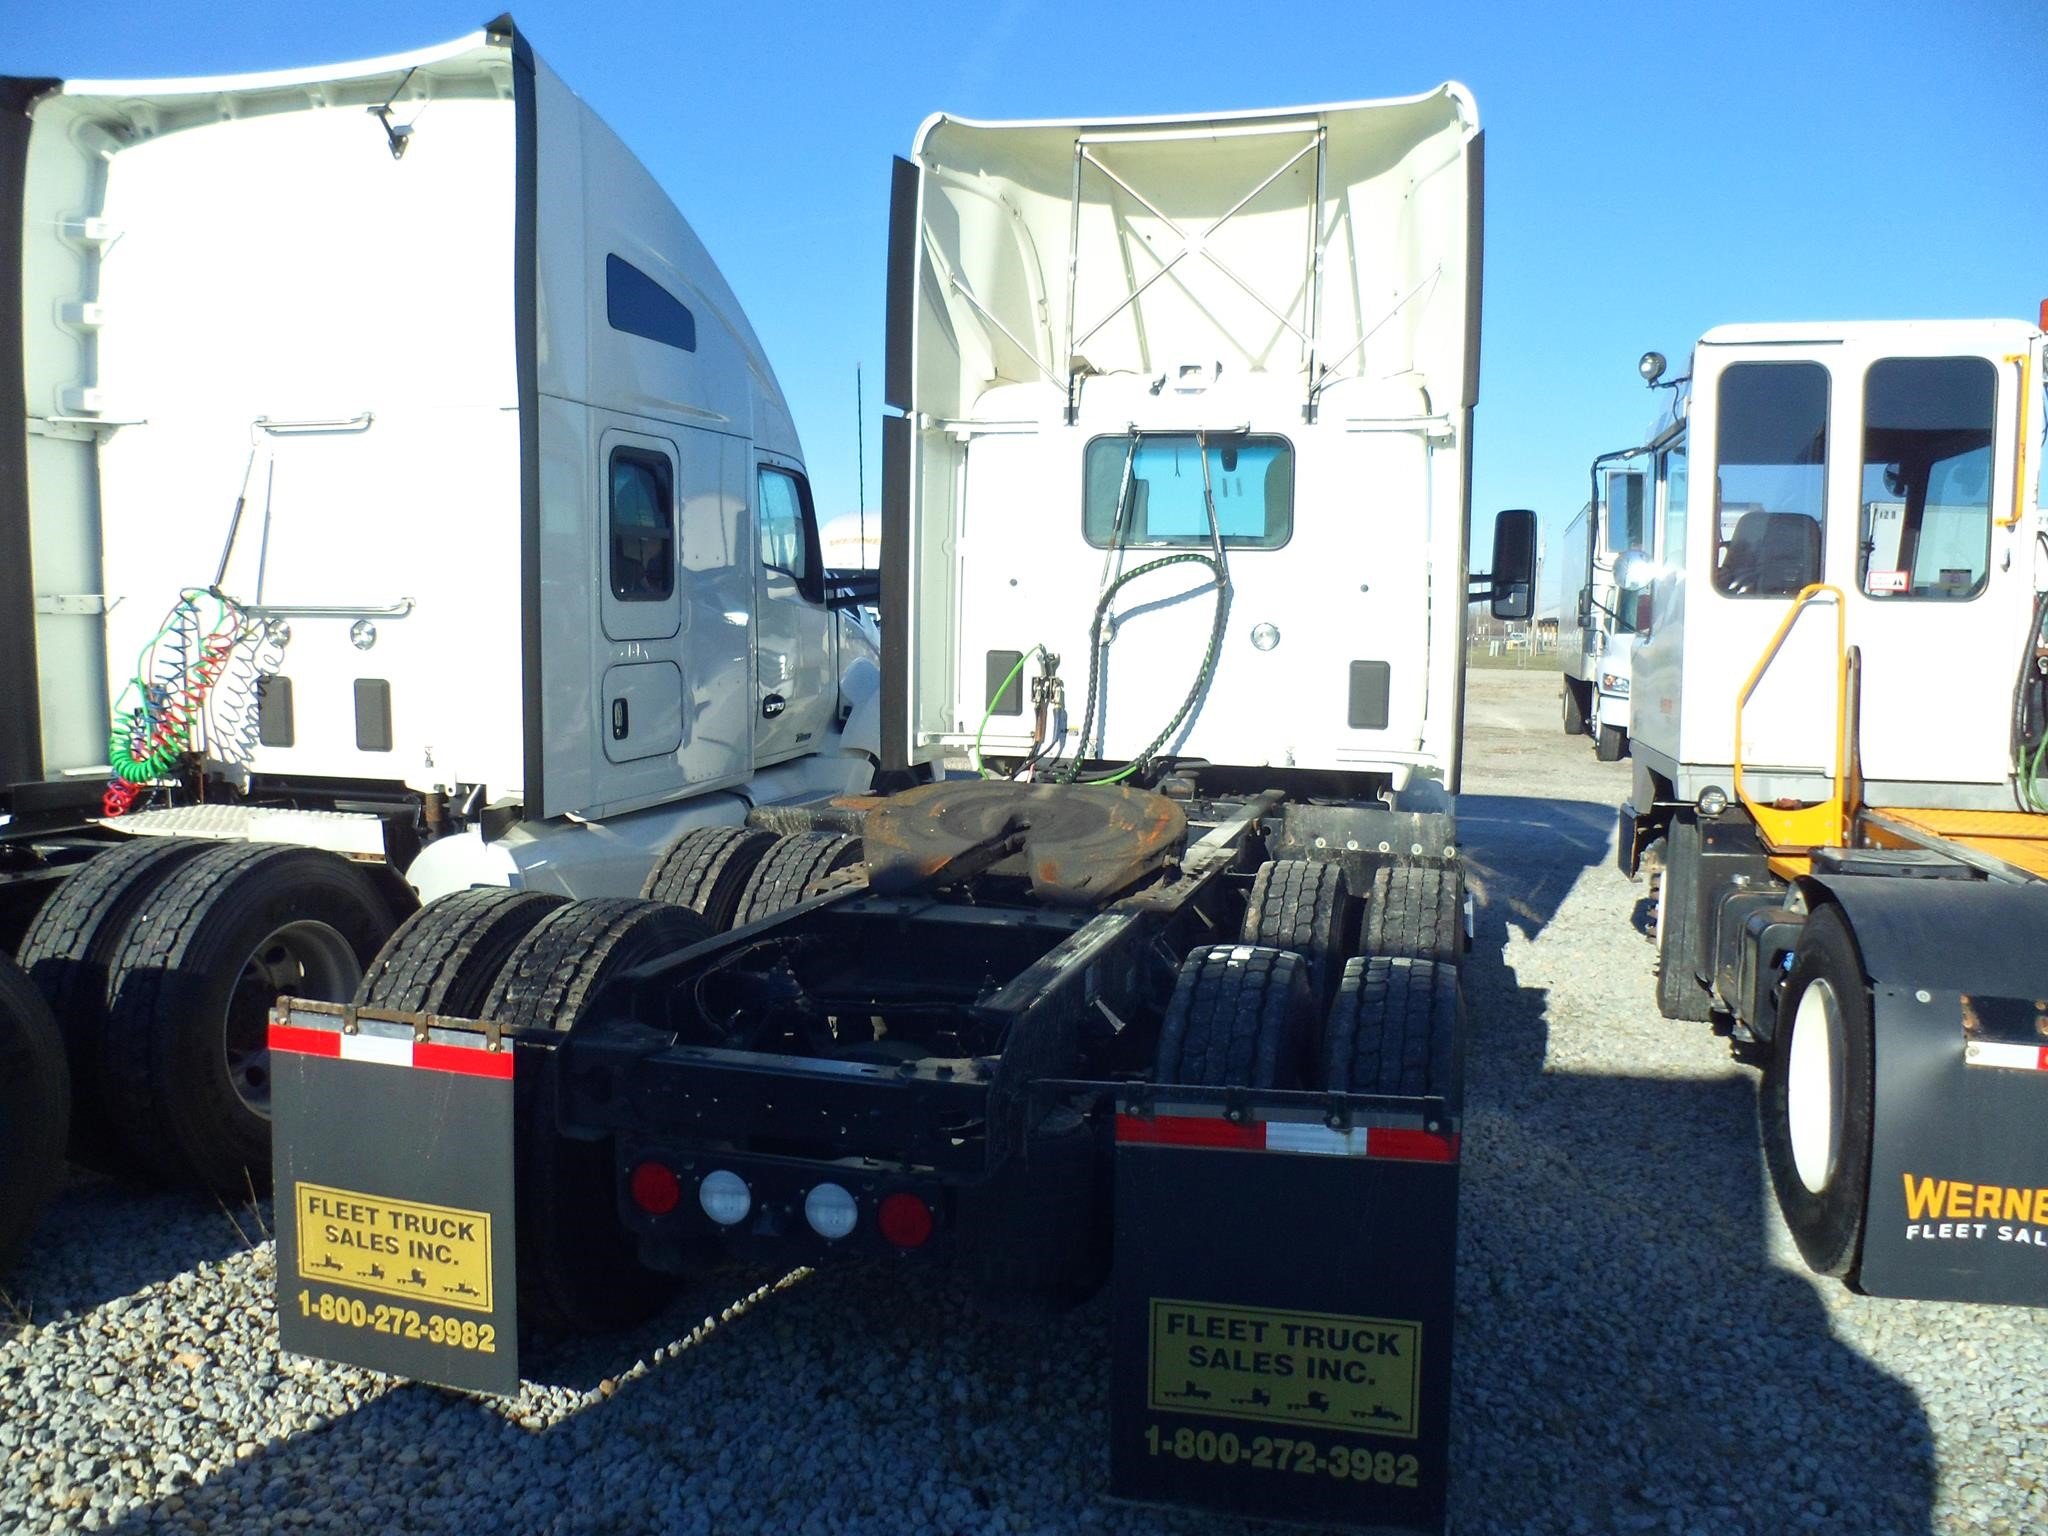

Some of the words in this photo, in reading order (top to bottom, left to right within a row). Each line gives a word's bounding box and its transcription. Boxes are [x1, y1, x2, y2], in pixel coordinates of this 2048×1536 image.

[308, 1196, 380, 1226] FLEET
[388, 1210, 476, 1242] TRUCK
[1905, 1223, 1987, 1240] FLEET
[1997, 1225, 2048, 1247] SAL
[325, 1224, 400, 1255] SALES
[408, 1239, 460, 1265] INC.
[298, 1289, 496, 1353] 1-800-272-3982
[1167, 1313, 1269, 1343] FLEET
[1280, 1323, 1401, 1357] TRUCK
[1188, 1345, 1295, 1377] SALES
[1306, 1356, 1377, 1386] INC.
[1144, 1424, 1420, 1488] 1-800-272-3982
